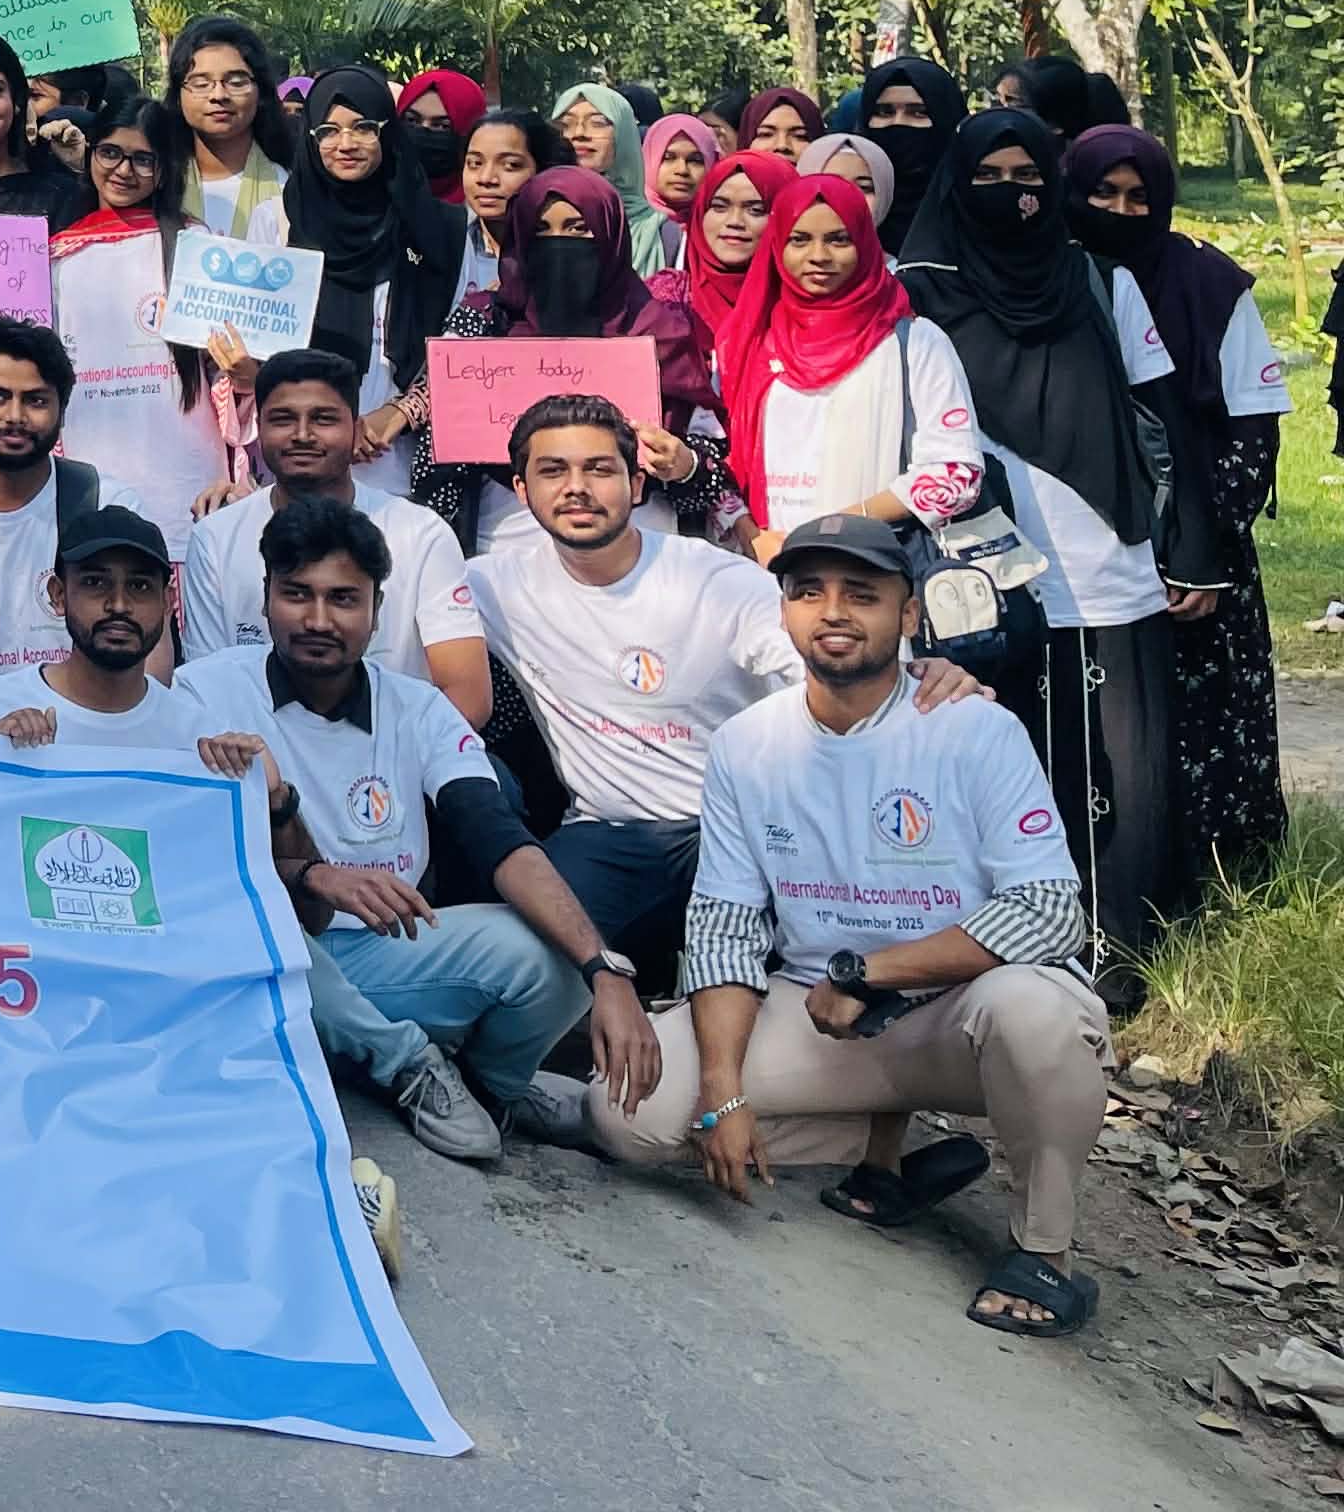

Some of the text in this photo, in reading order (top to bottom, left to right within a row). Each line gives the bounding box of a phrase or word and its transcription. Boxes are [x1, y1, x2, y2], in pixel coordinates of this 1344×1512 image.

[48, 9, 115, 33] is our
[16, 236, 47, 255] The
[7, 270, 27, 292] of
[183, 284, 298, 320] INTERNATIONAL
[173, 301, 269, 331] ACCOUNTING
[270, 318, 301, 337] DAY
[77, 365, 114, 384] national
[115, 361, 170, 381] Accounting
[100, 386, 140, 398] November
[236, 623, 263, 636] Tally
[669, 720, 693, 742] Day
[764, 824, 796, 841] Tally
[766, 843, 799, 857] Prime
[775, 875, 961, 911] International Accounting Day
[837, 915, 892, 930] November
[895, 917, 924, 930] 2025
